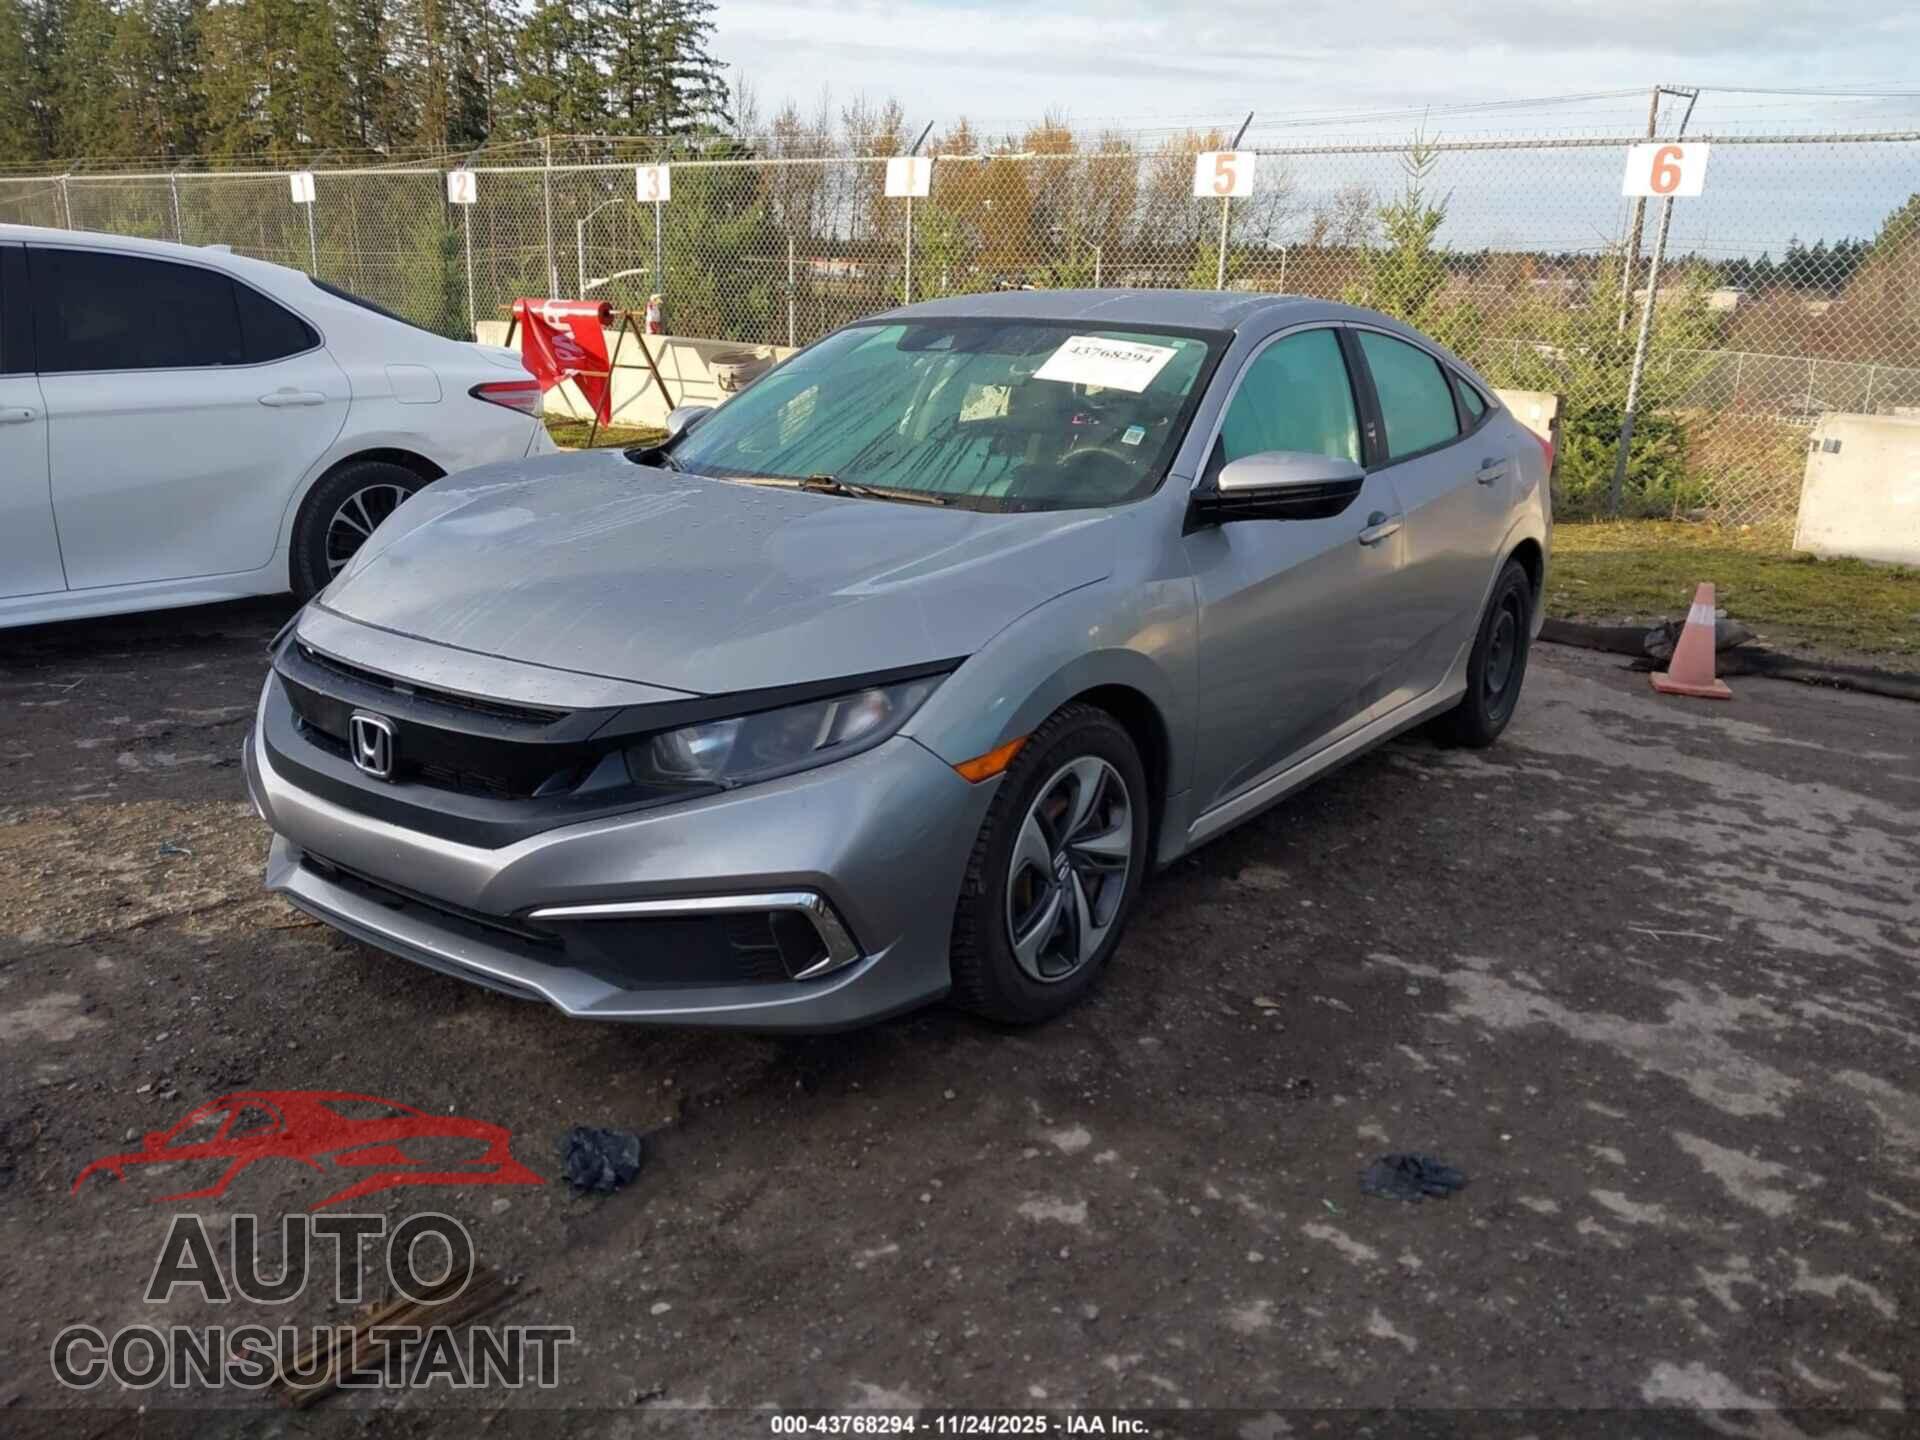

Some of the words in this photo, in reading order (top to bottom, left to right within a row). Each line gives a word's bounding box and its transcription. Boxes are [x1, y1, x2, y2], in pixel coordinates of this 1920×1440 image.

[456, 173, 469, 202] 2
[647, 168, 660, 199] 3
[1214, 153, 1236, 194] 5
[1650, 145, 1683, 194] 6
